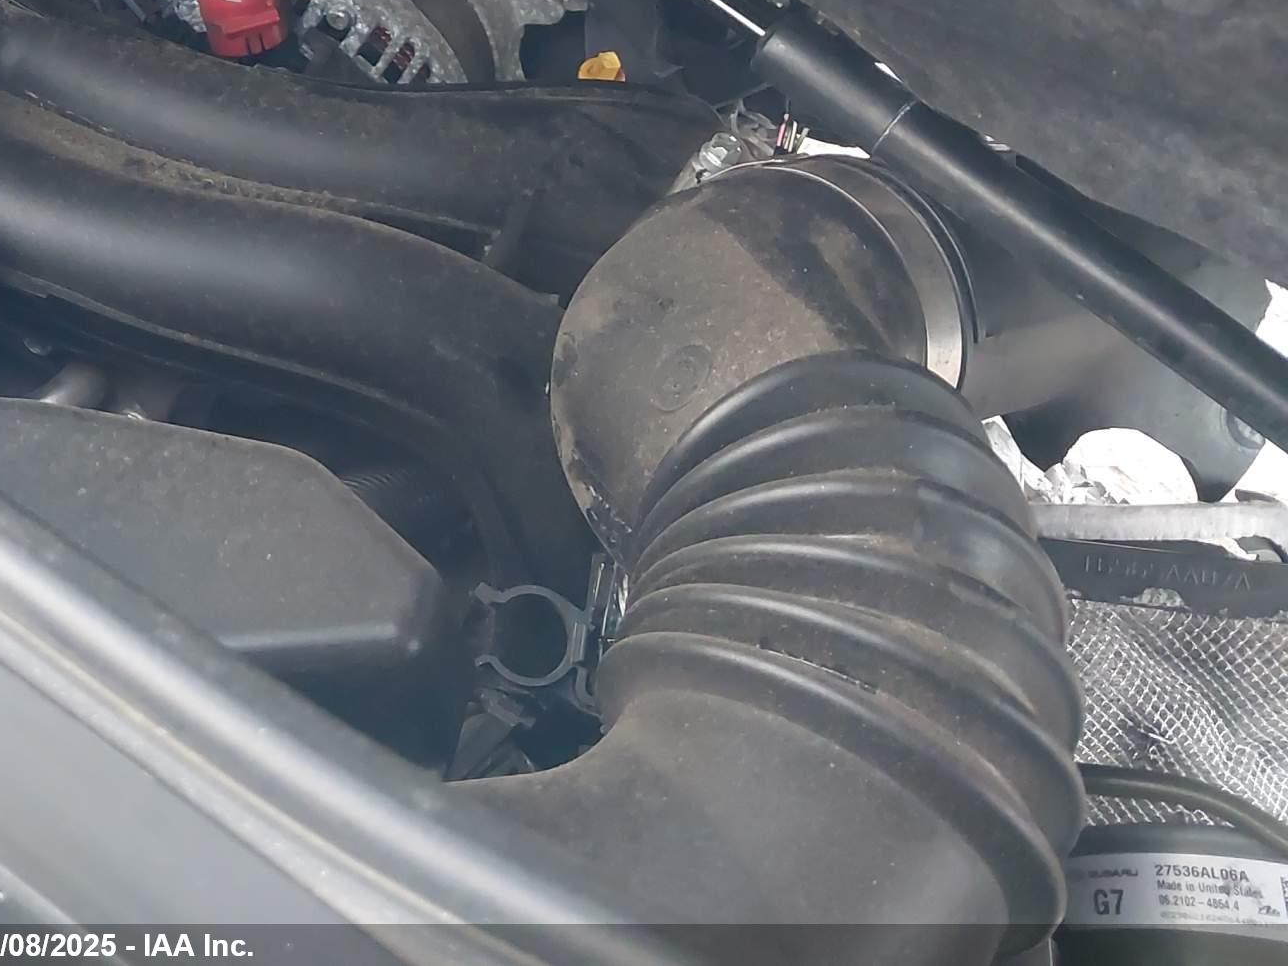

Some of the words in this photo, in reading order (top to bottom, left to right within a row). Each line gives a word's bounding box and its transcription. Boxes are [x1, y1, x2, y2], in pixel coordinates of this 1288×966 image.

[1154, 864, 1250, 882] 27536AL06A
[1157, 880, 1182, 891] Made
[1186, 880, 1196, 892] in
[1198, 882, 1231, 896] United
[1093, 889, 1124, 915] G7
